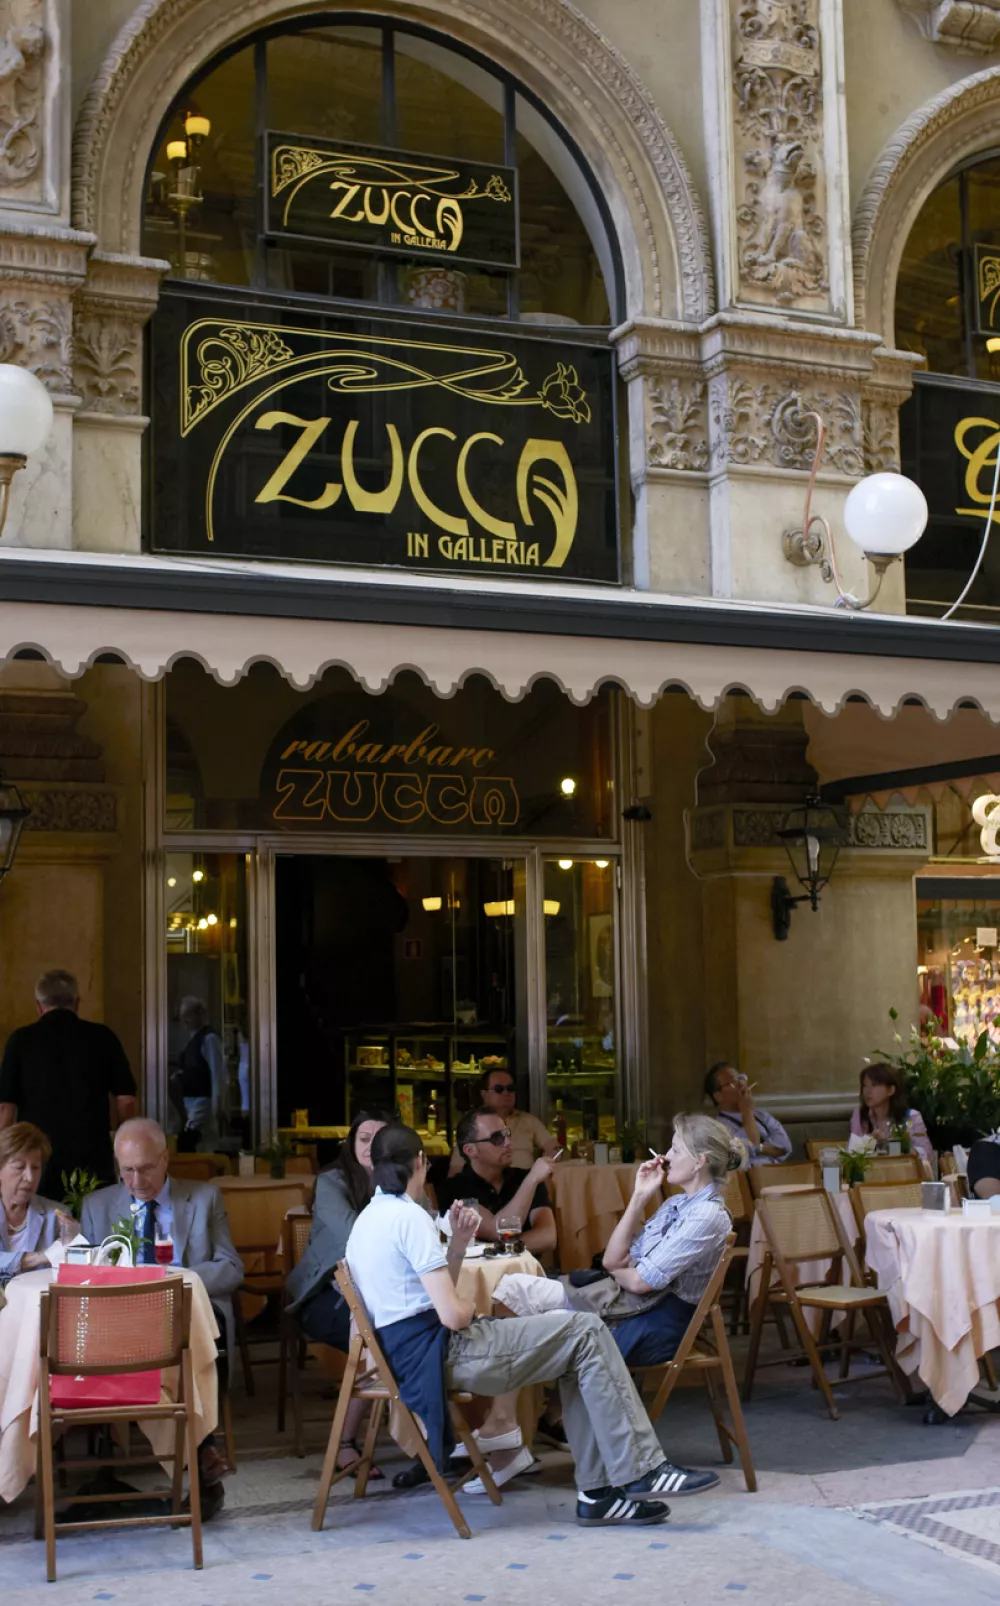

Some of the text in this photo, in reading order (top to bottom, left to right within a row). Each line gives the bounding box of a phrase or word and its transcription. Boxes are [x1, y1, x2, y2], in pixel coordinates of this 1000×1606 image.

[329, 181, 463, 251] ZUCCA
[390, 232, 447, 250] IN GALLERIA
[254, 410, 579, 568] ZUCCA
[407, 532, 540, 567] IN GALLERIA
[273, 769, 520, 825] ZUCCA
